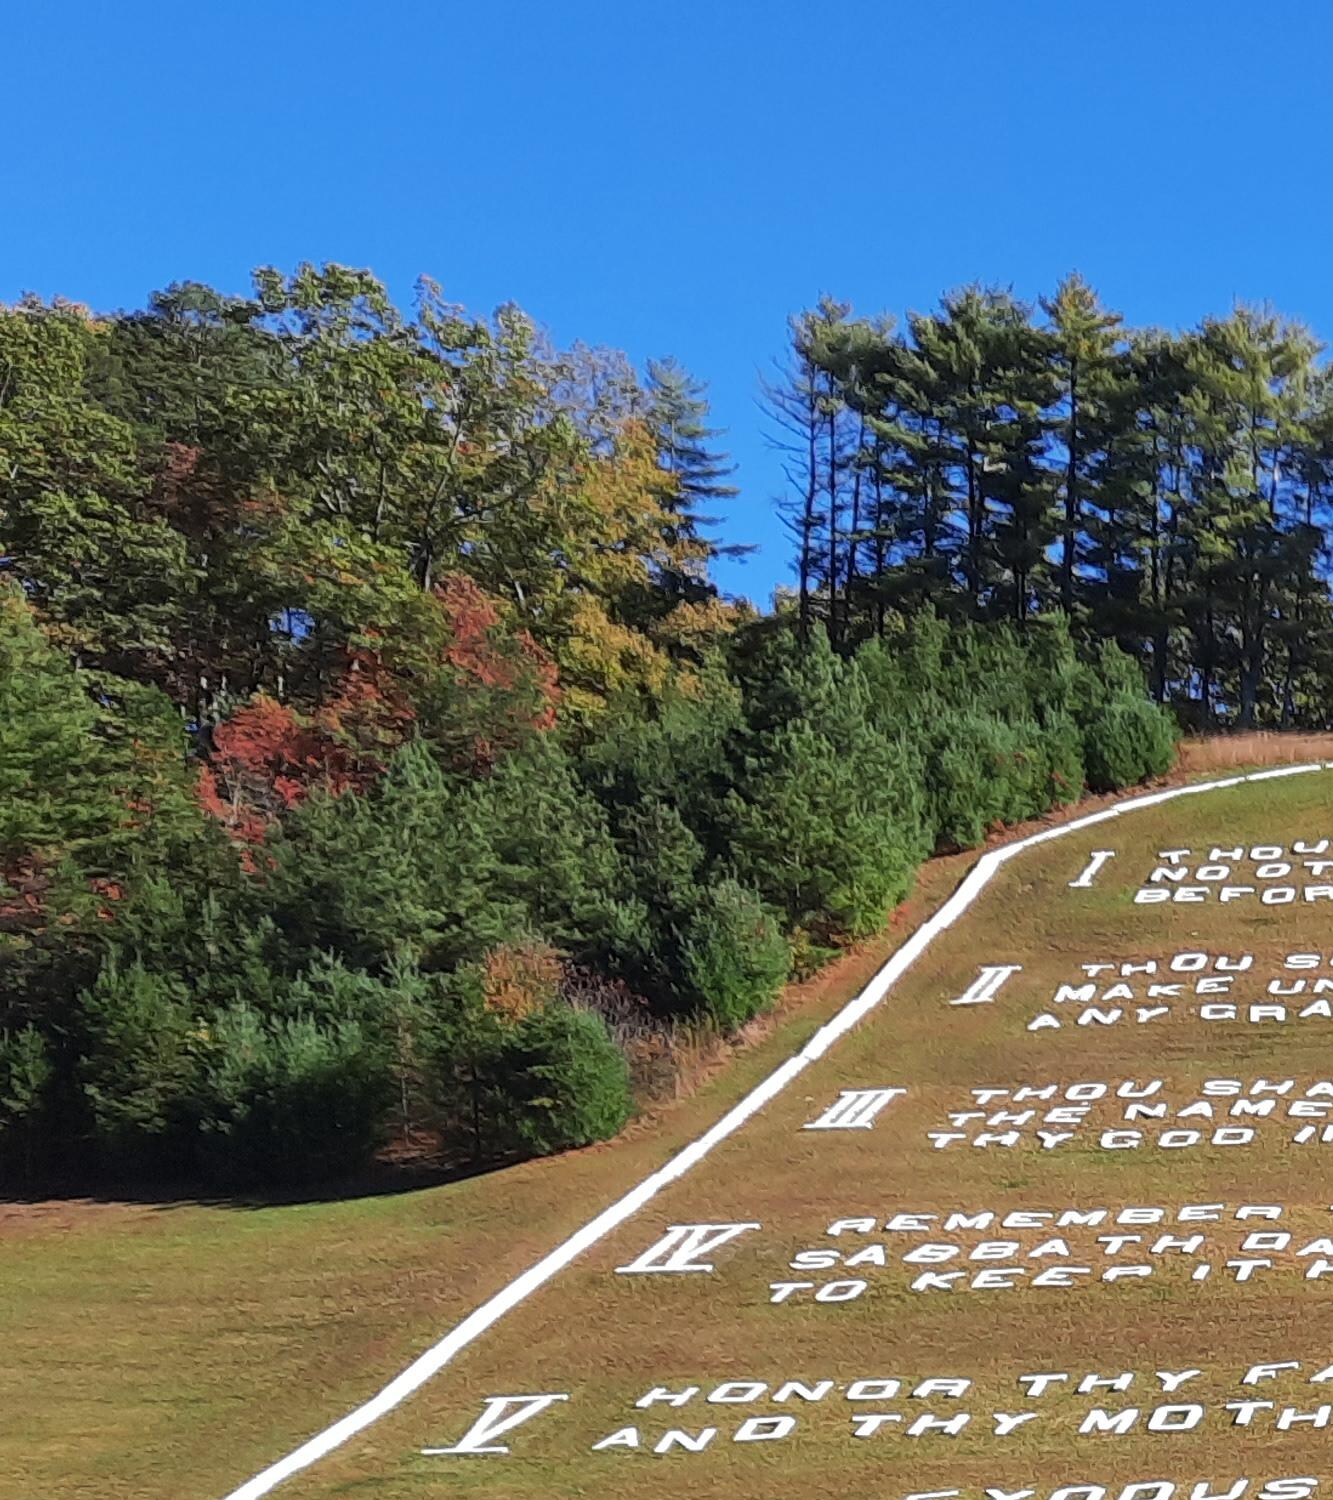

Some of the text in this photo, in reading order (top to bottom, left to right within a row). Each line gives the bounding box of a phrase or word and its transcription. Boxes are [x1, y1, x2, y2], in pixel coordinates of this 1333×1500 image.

[1068, 850, 1115, 888] I
[1158, 839, 1330, 865] THOU
[1150, 865, 1230, 882] NO
[1081, 952, 1253, 977] THOU
[949, 965, 1023, 1005] II
[1053, 975, 1234, 1003] MAKE
[1027, 1006, 1169, 1031] ANY
[803, 1088, 907, 1129] III
[971, 1080, 1163, 1105] THOU
[948, 1106, 1091, 1127] THE
[1124, 1099, 1333, 1121] NAME
[927, 1130, 1074, 1149] THY
[1100, 1127, 1255, 1149] GOD
[826, 1203, 1282, 1236] REMEMBER
[614, 1222, 761, 1273] IV
[789, 1234, 1205, 1270] SABBATH
[769, 1279, 868, 1303] TO
[911, 1265, 1153, 1292] KEEP
[1192, 1259, 1272, 1281] IT
[635, 1378, 971, 1408] HONOR
[1019, 1369, 1201, 1397] THY
[420, 1393, 569, 1455] V
[591, 1415, 796, 1453] AND
[852, 1412, 1039, 1437] THY
